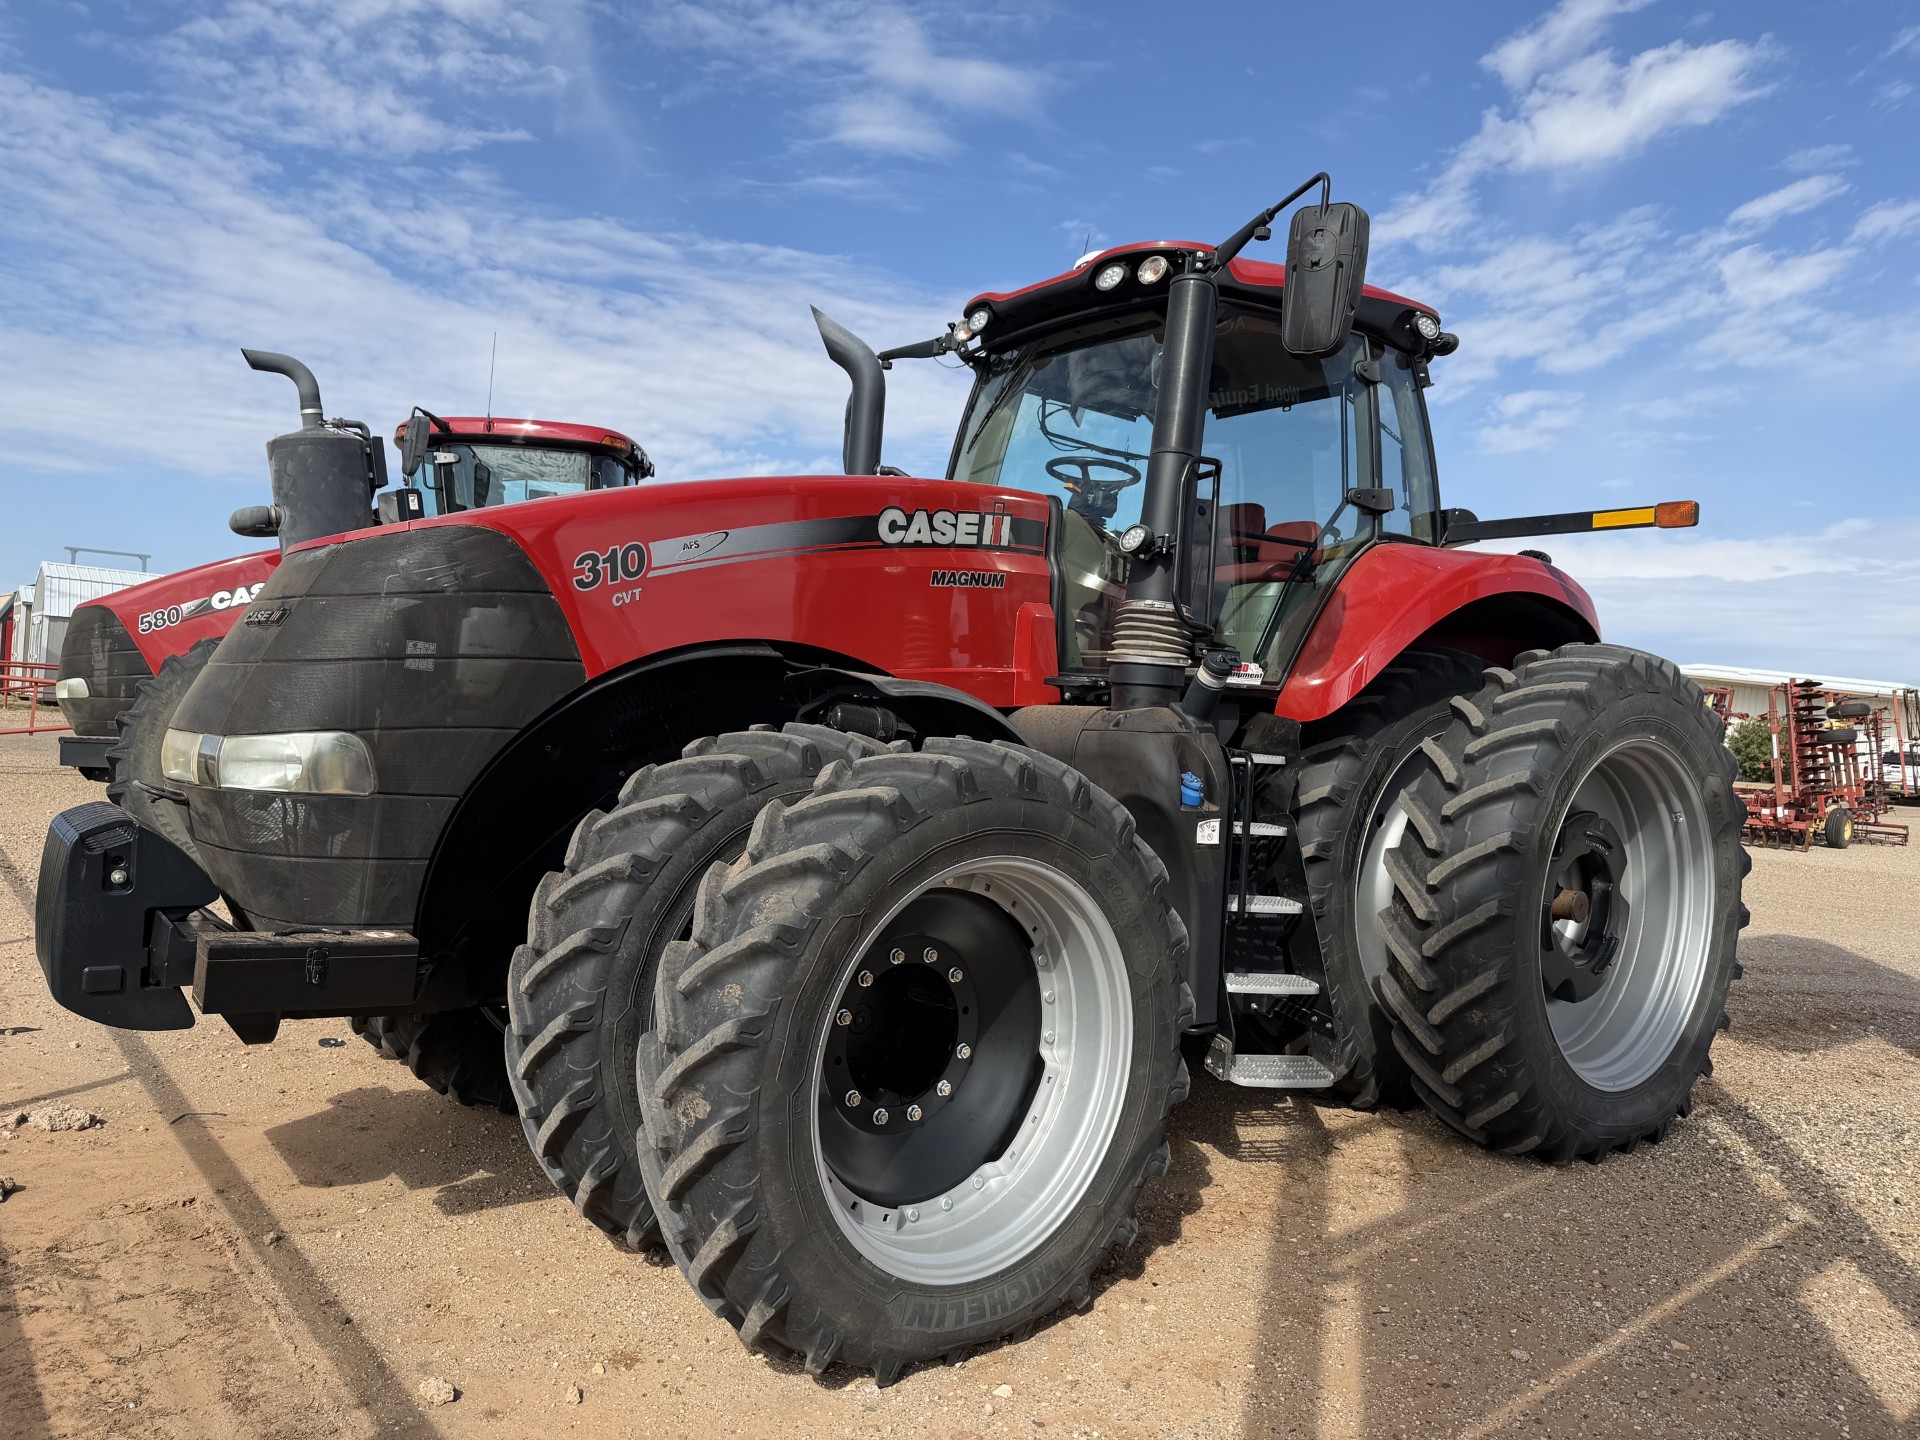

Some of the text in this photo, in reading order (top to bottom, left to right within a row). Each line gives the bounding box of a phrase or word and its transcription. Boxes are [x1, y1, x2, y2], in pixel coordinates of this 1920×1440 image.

[877, 506, 981, 547] CASE
[682, 540, 700, 551] AFS
[573, 541, 647, 591] 310
[930, 570, 1006, 588] MAGNUM
[612, 588, 642, 606] CVT
[138, 605, 182, 634] 580
[244, 610, 271, 622] CASE
[903, 1255, 1068, 1329] MICHELIN
